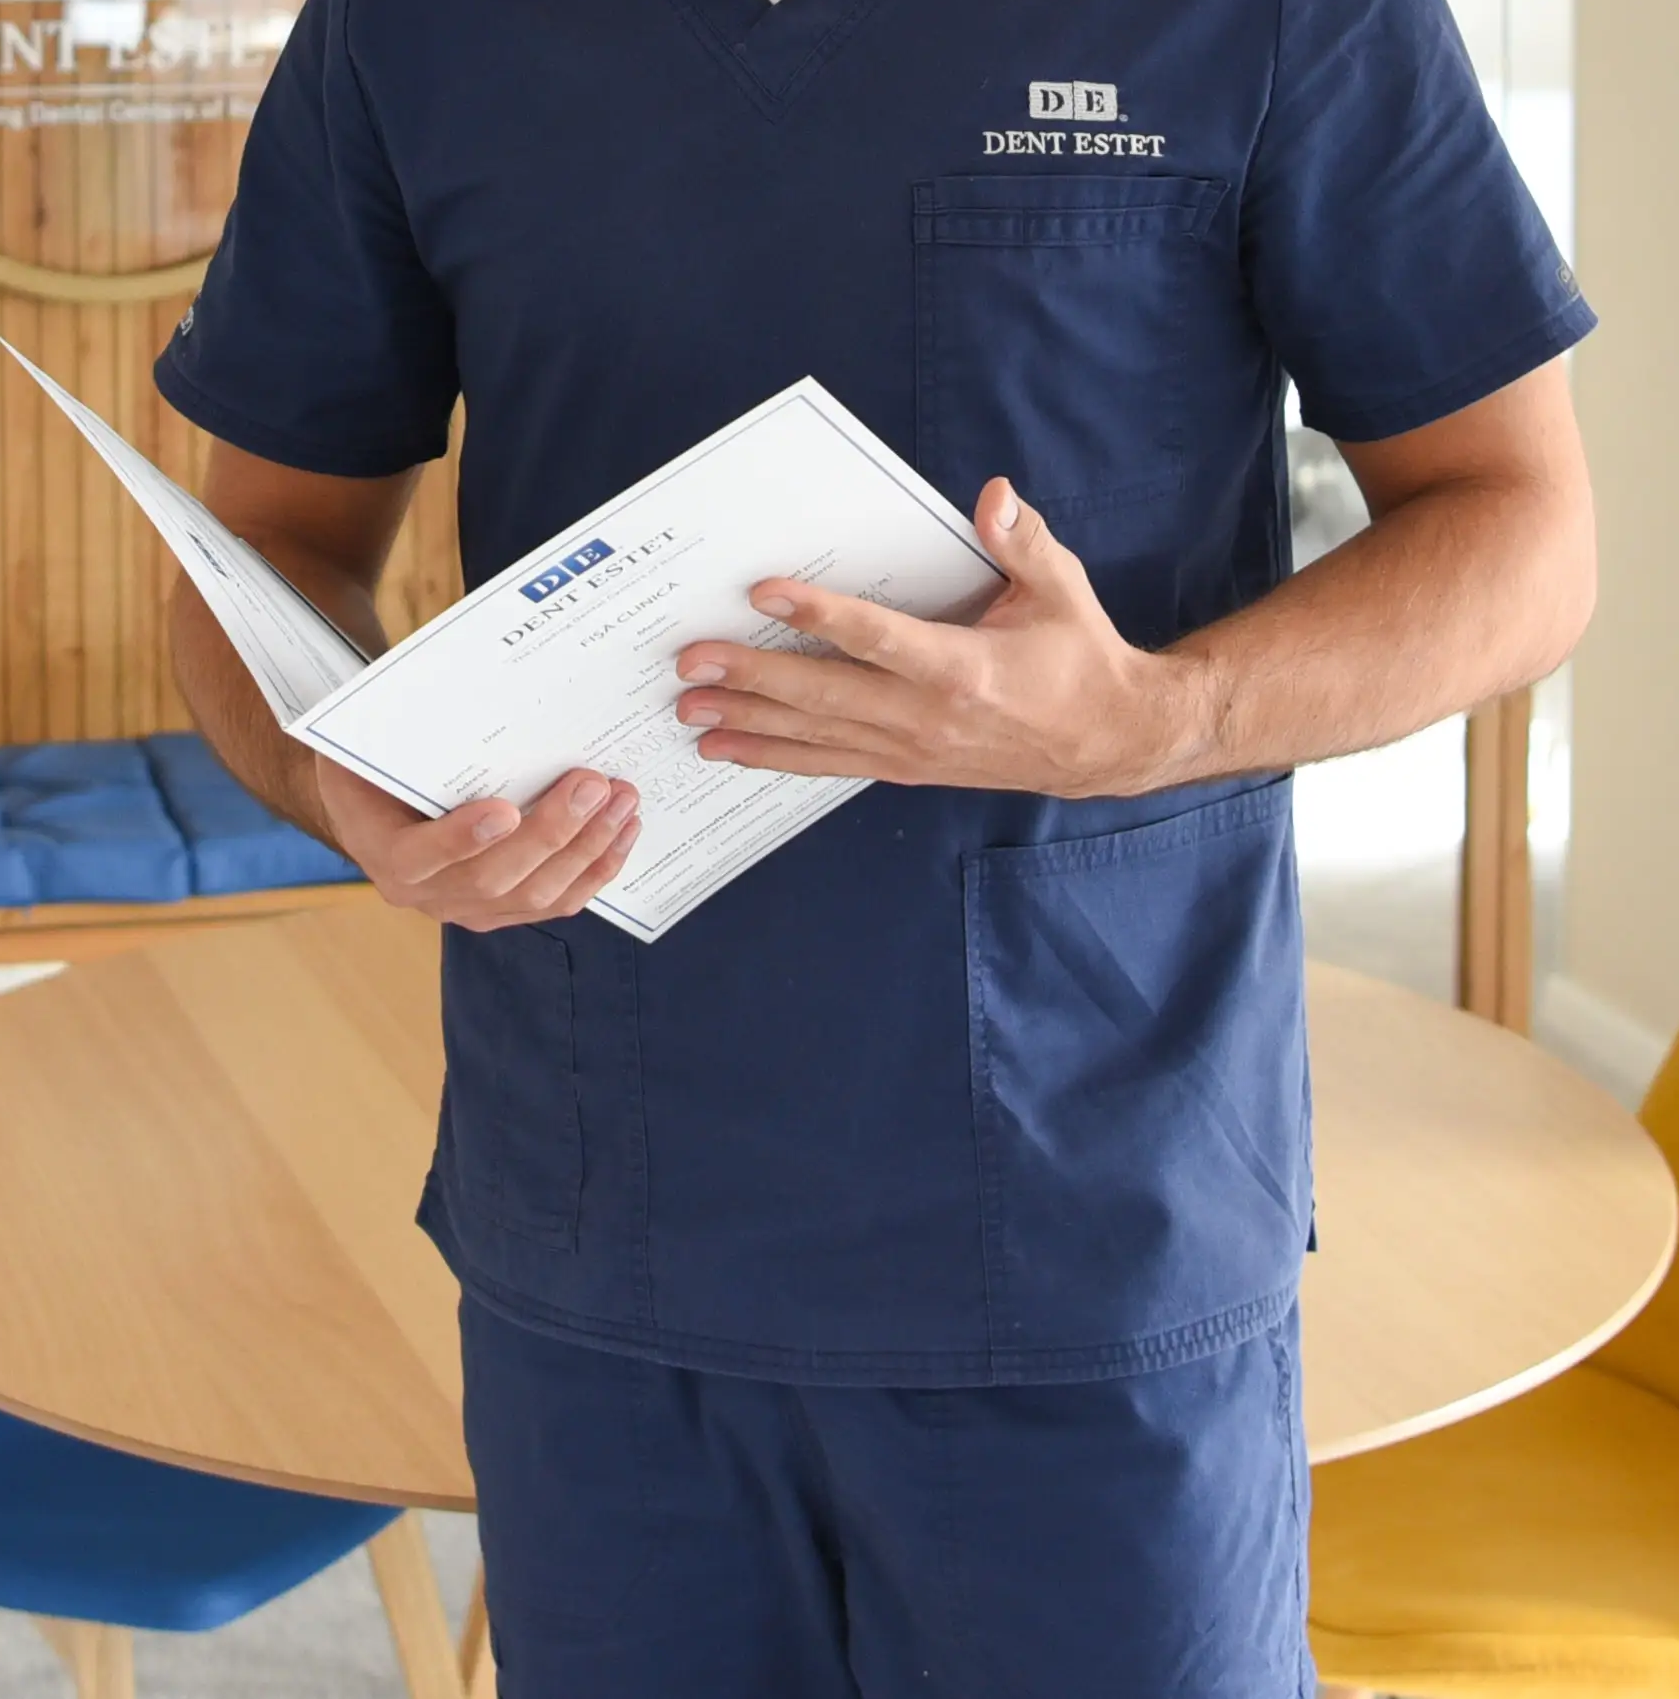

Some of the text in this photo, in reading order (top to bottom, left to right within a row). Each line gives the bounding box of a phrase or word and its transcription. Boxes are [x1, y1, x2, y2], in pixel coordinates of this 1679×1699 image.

[106, 16, 284, 72] ESTE
[982, 130, 1166, 158] DENT ESTET
[501, 527, 676, 647] DENT ESTET
